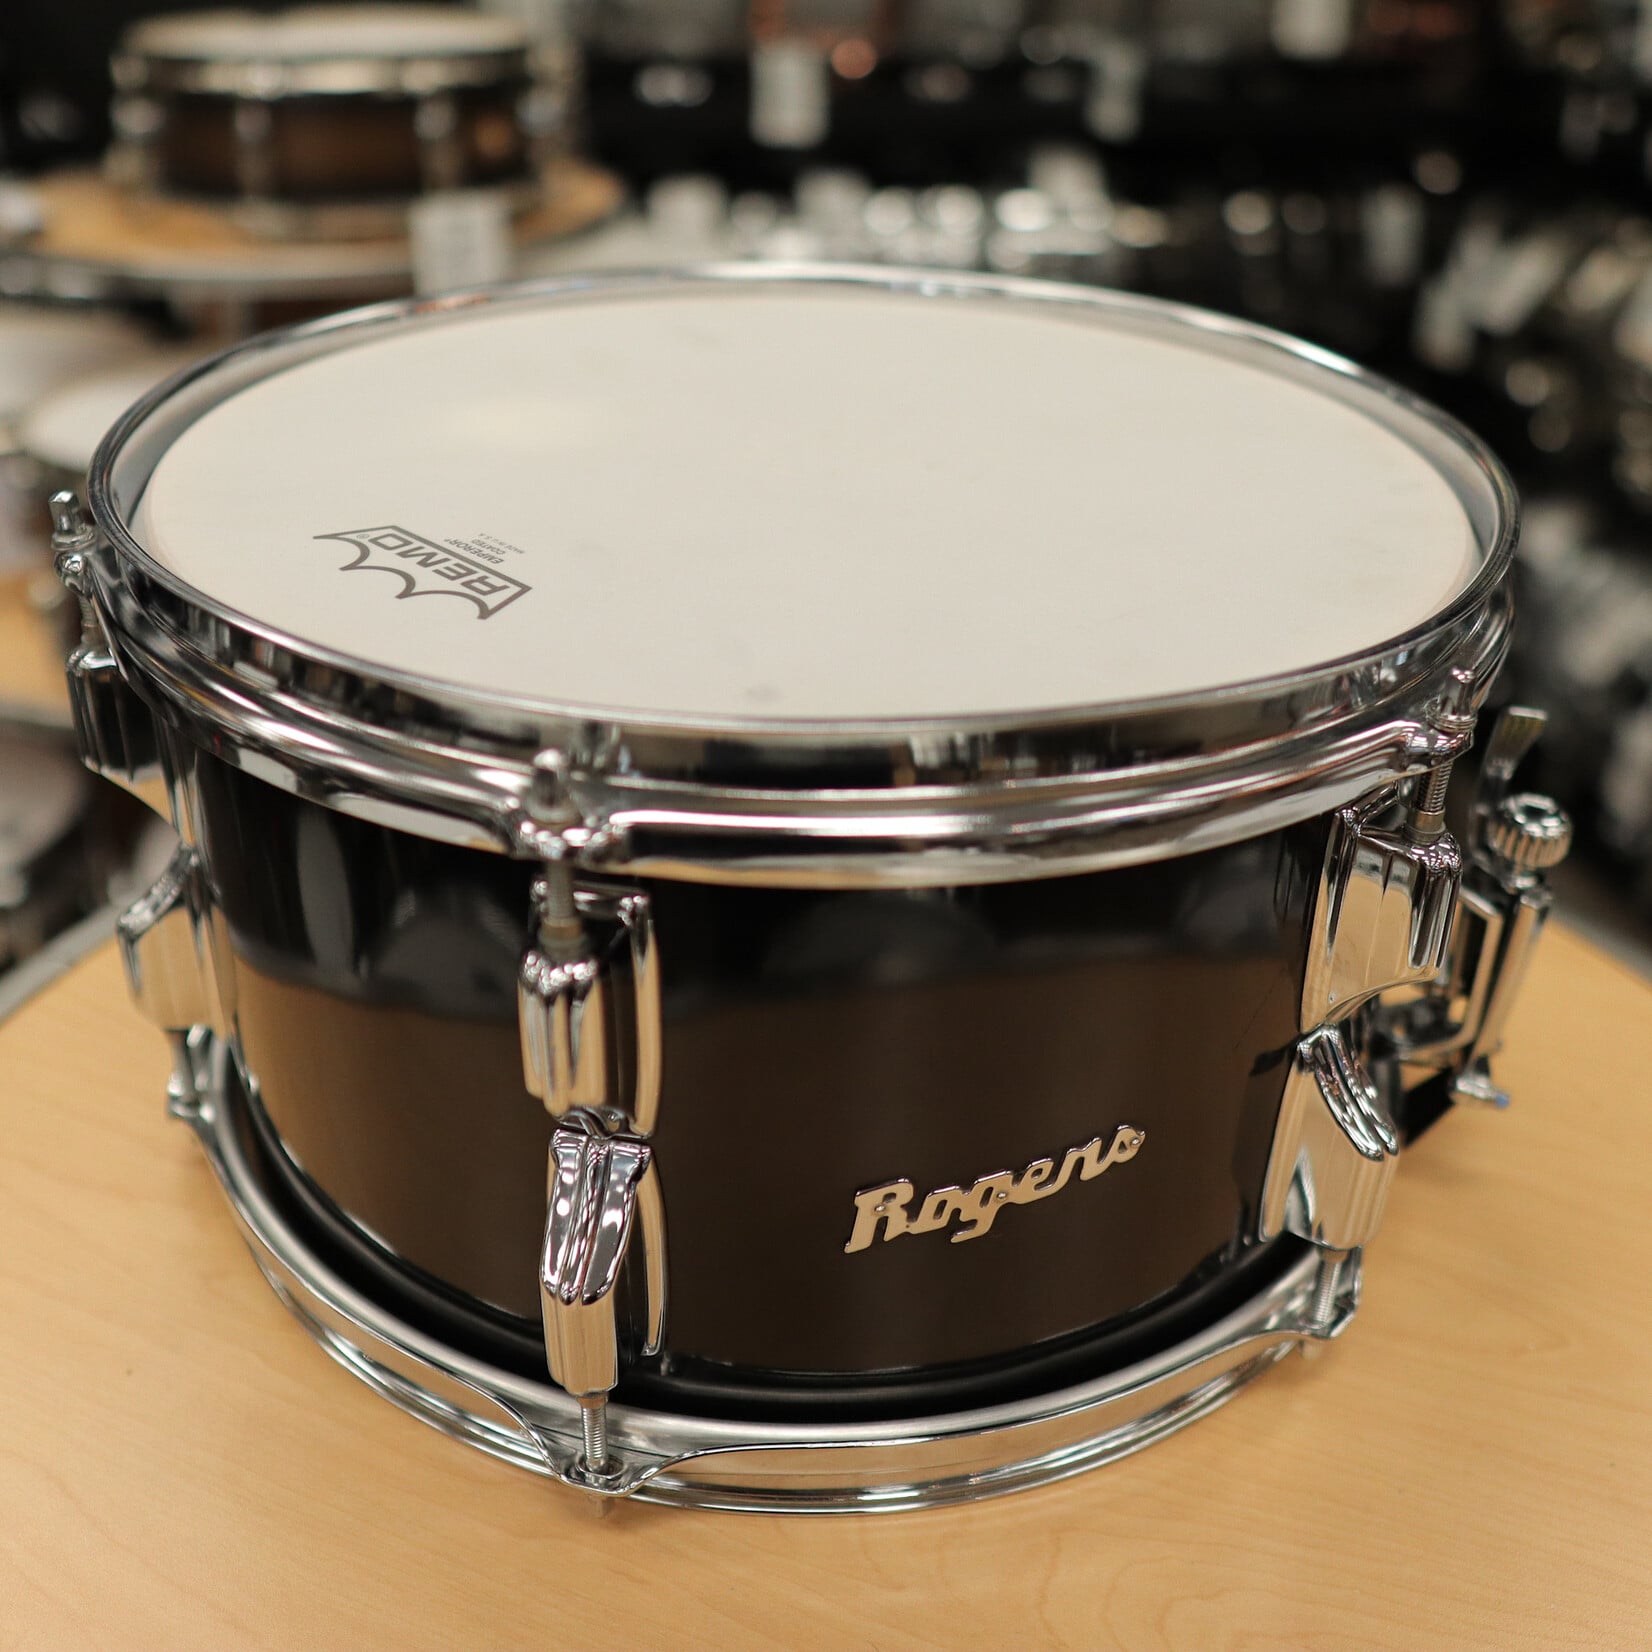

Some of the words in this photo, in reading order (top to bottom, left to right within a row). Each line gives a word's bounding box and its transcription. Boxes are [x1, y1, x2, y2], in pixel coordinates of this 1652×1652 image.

[368, 533, 510, 596] REMO
[471, 539, 506, 555] COATED
[844, 1125, 1145, 1254] Rogers
